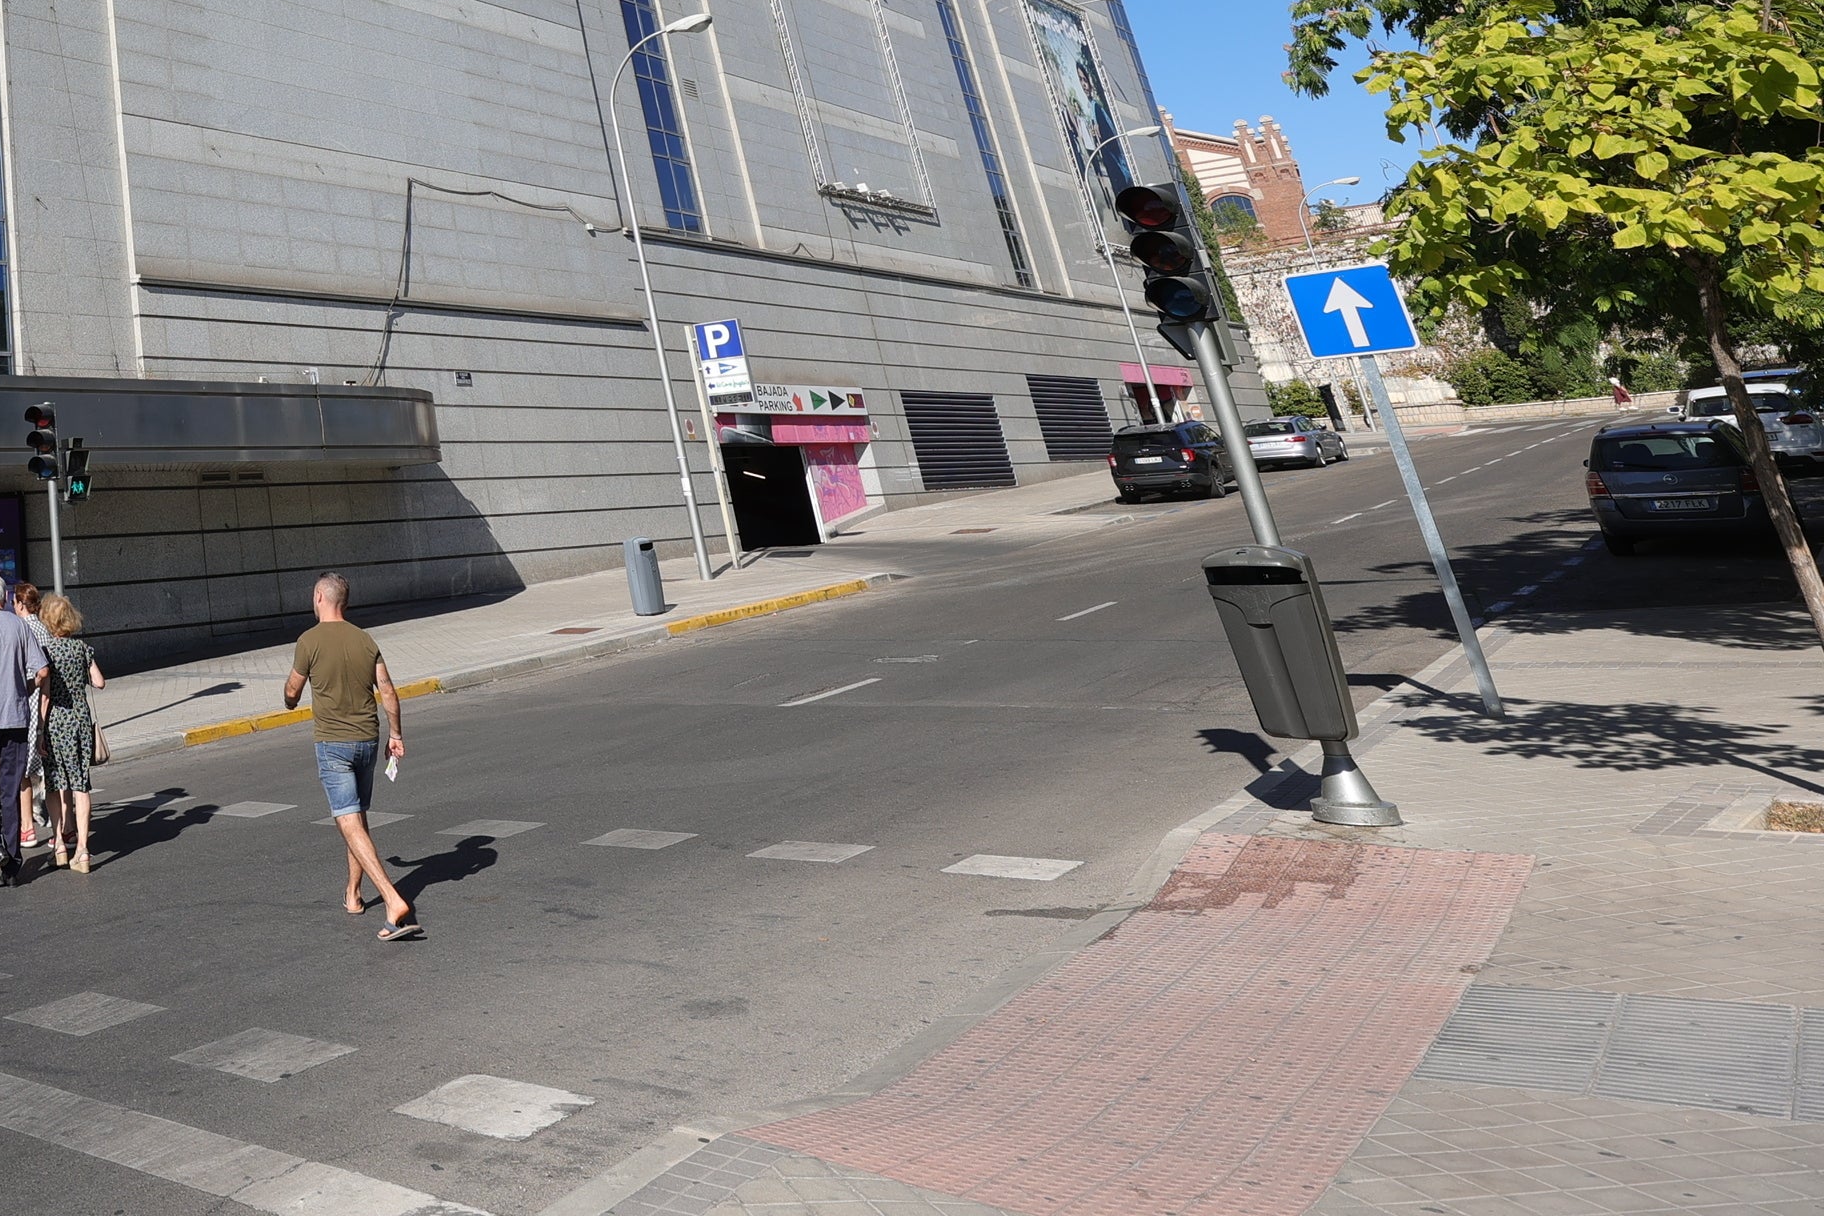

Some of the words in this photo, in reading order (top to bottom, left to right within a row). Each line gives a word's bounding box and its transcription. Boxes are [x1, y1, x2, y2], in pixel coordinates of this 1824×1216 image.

[703, 323, 730, 359] P
[756, 385, 789, 397] BAJADA
[758, 400, 793, 412] PARKING
